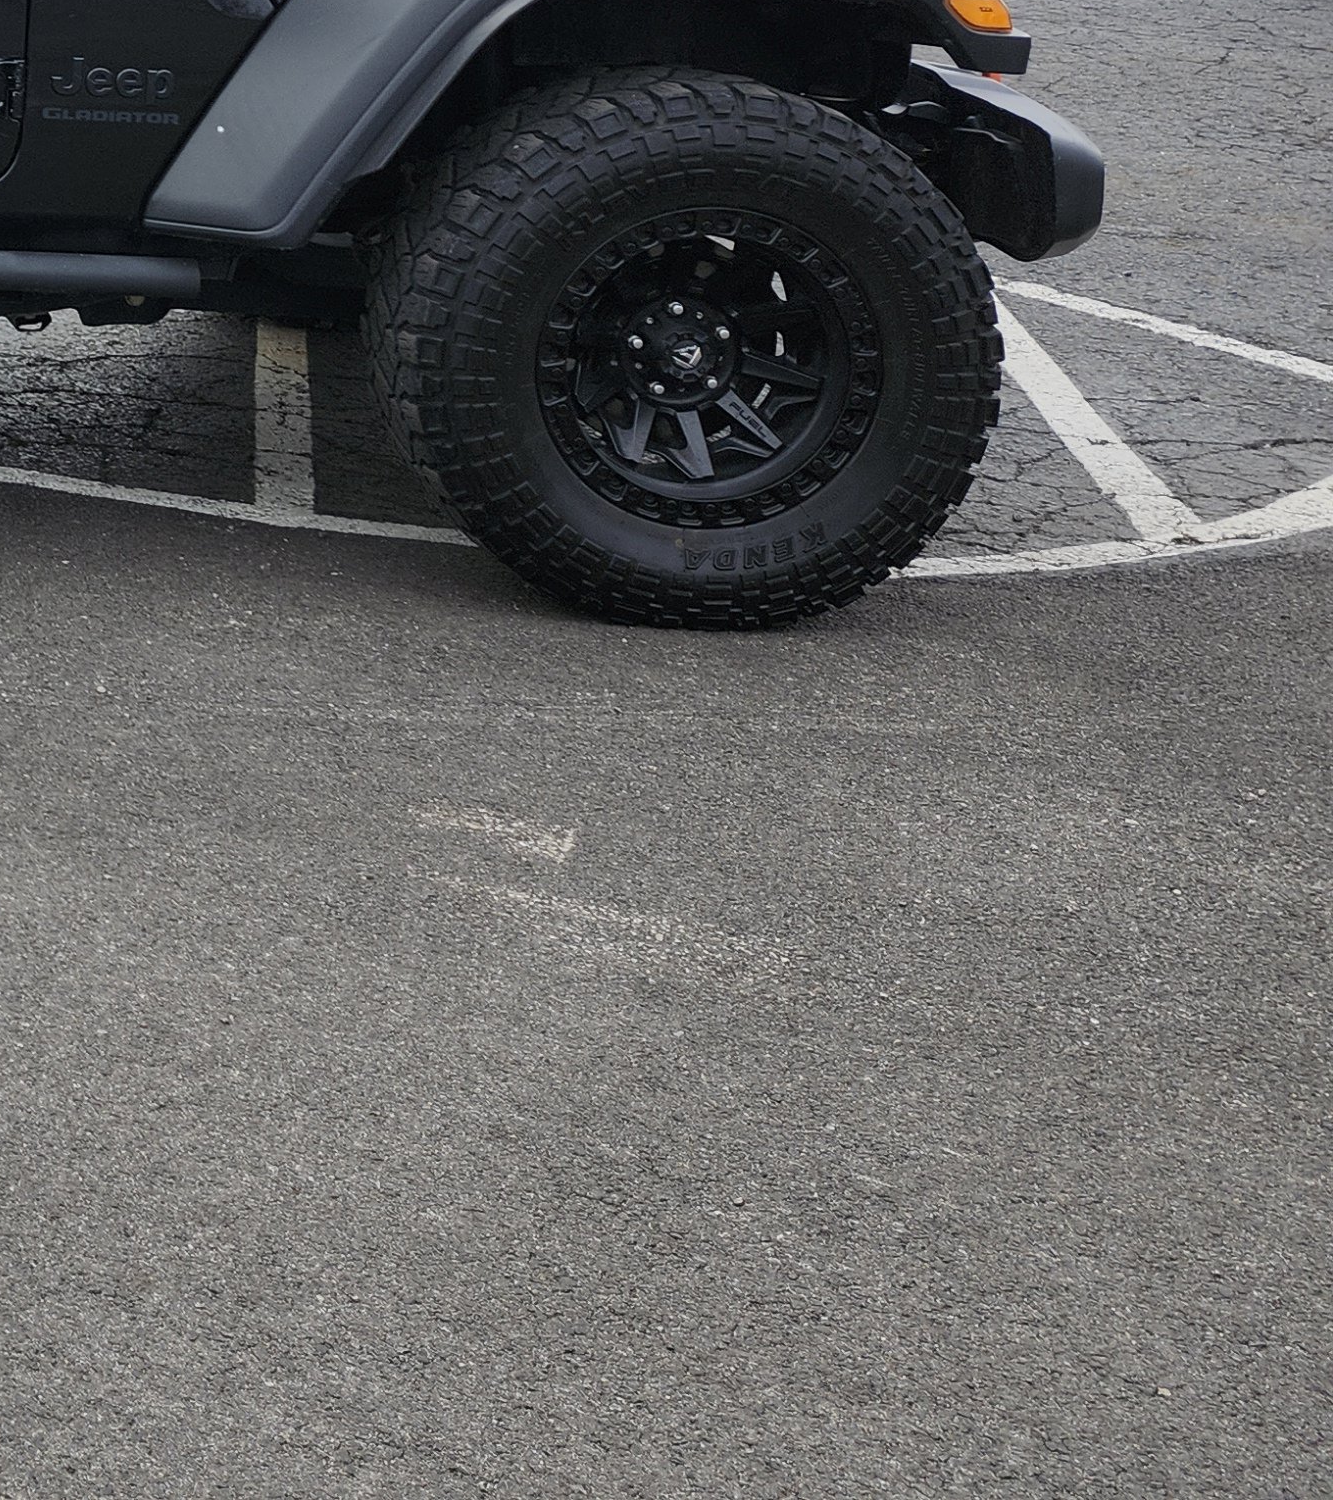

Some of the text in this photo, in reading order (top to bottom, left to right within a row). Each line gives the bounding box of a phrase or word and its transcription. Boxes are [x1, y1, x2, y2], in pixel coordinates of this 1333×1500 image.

[50, 56, 175, 100] Jeep
[41, 107, 180, 125] GLADIATOR
[729, 401, 767, 438] FUEL
[684, 521, 829, 571] KENDA
